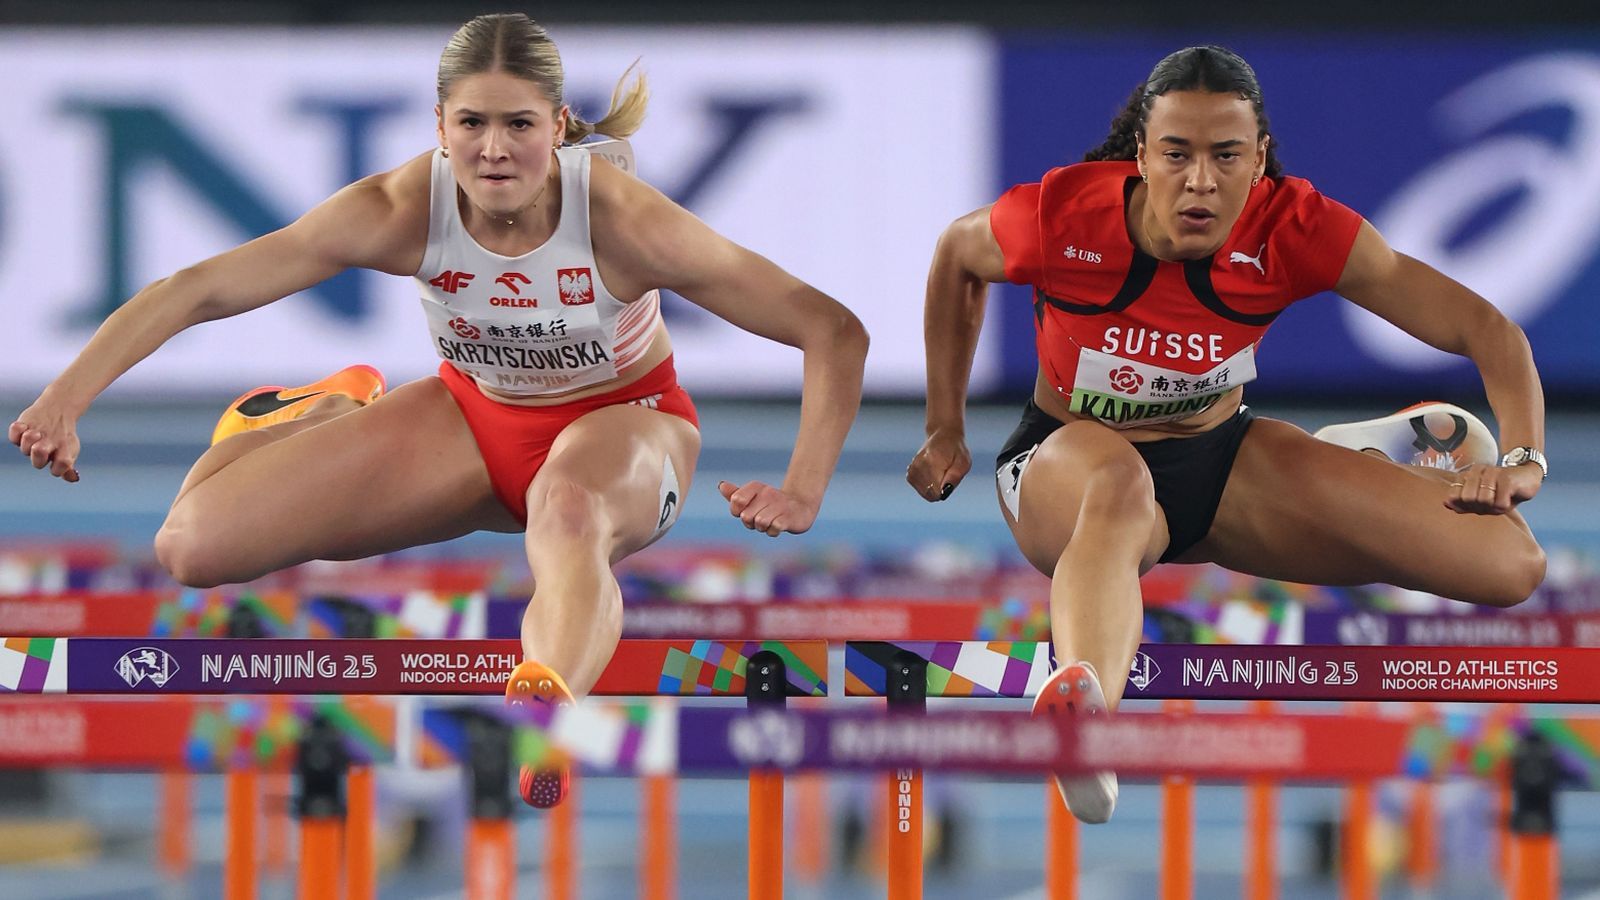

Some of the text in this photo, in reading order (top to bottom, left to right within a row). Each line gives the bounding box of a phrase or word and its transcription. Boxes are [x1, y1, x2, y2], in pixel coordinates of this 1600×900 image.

[1078, 249, 1102, 263] UBS
[489, 297, 538, 308] ORLEN
[486, 318, 568, 339] 南京银行
[438, 335, 610, 371] SKRZYSZOWSKA
[1150, 366, 1231, 393] 南京银行
[201, 650, 378, 685] NANJING 25
[401, 653, 518, 669] WORLD ATHL
[1382, 660, 1558, 676] WORLD ATHLETICS
[400, 671, 512, 684] INDOOR CHAMP
[1182, 656, 1359, 690] NANJING 25
[1381, 677, 1559, 691] INDOOR CHAMPIONSHIPS
